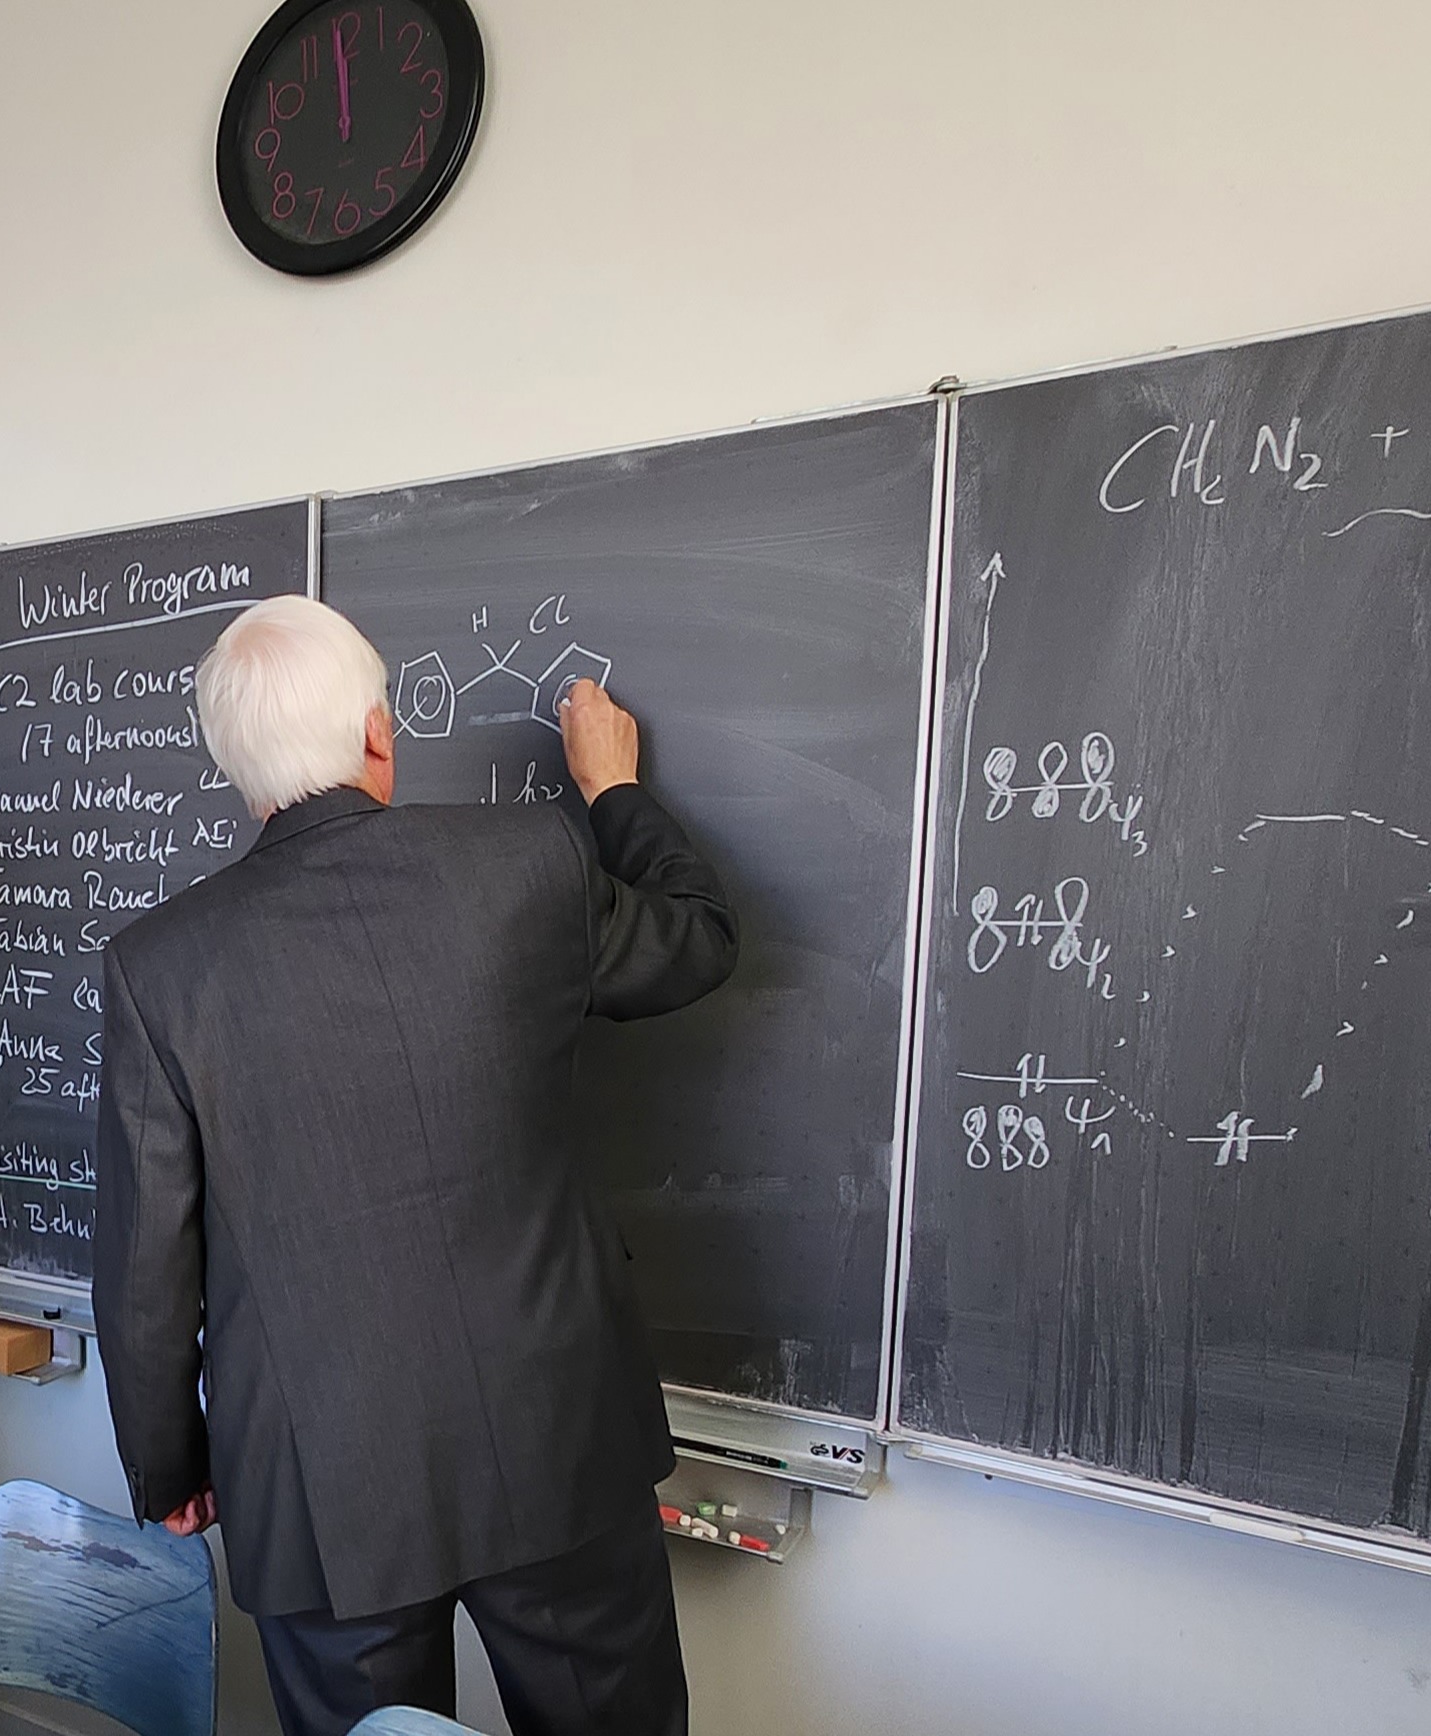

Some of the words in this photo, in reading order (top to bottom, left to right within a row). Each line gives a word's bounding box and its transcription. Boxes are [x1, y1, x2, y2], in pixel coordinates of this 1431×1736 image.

[300, 34, 319, 84] 11
[397, 21, 423, 74] 2
[268, 80, 305, 125] 10
[420, 69, 443, 118] 3
[254, 127, 281, 172] 9
[400, 124, 425, 170] 4
[272, 172, 296, 219] 8
[304, 187, 325, 235] 7
[333, 188, 361, 235] 6
[369, 167, 396, 216] 5
[18, 571, 113, 629] Winter
[123, 561, 251, 615] Program
[471, 605, 488, 633] H
[50, 658, 102, 707] lab
[113, 664, 195, 698] cours
[20, 723, 54, 763] 17
[71, 772, 183, 817] Niederer
[71, 827, 180, 867] Olbricht
[77, 919, 111, 952] Sc
[73, 976, 103, 1013] la
[21, 1067, 61, 1094] 25
[61, 1072, 100, 1113] aft
